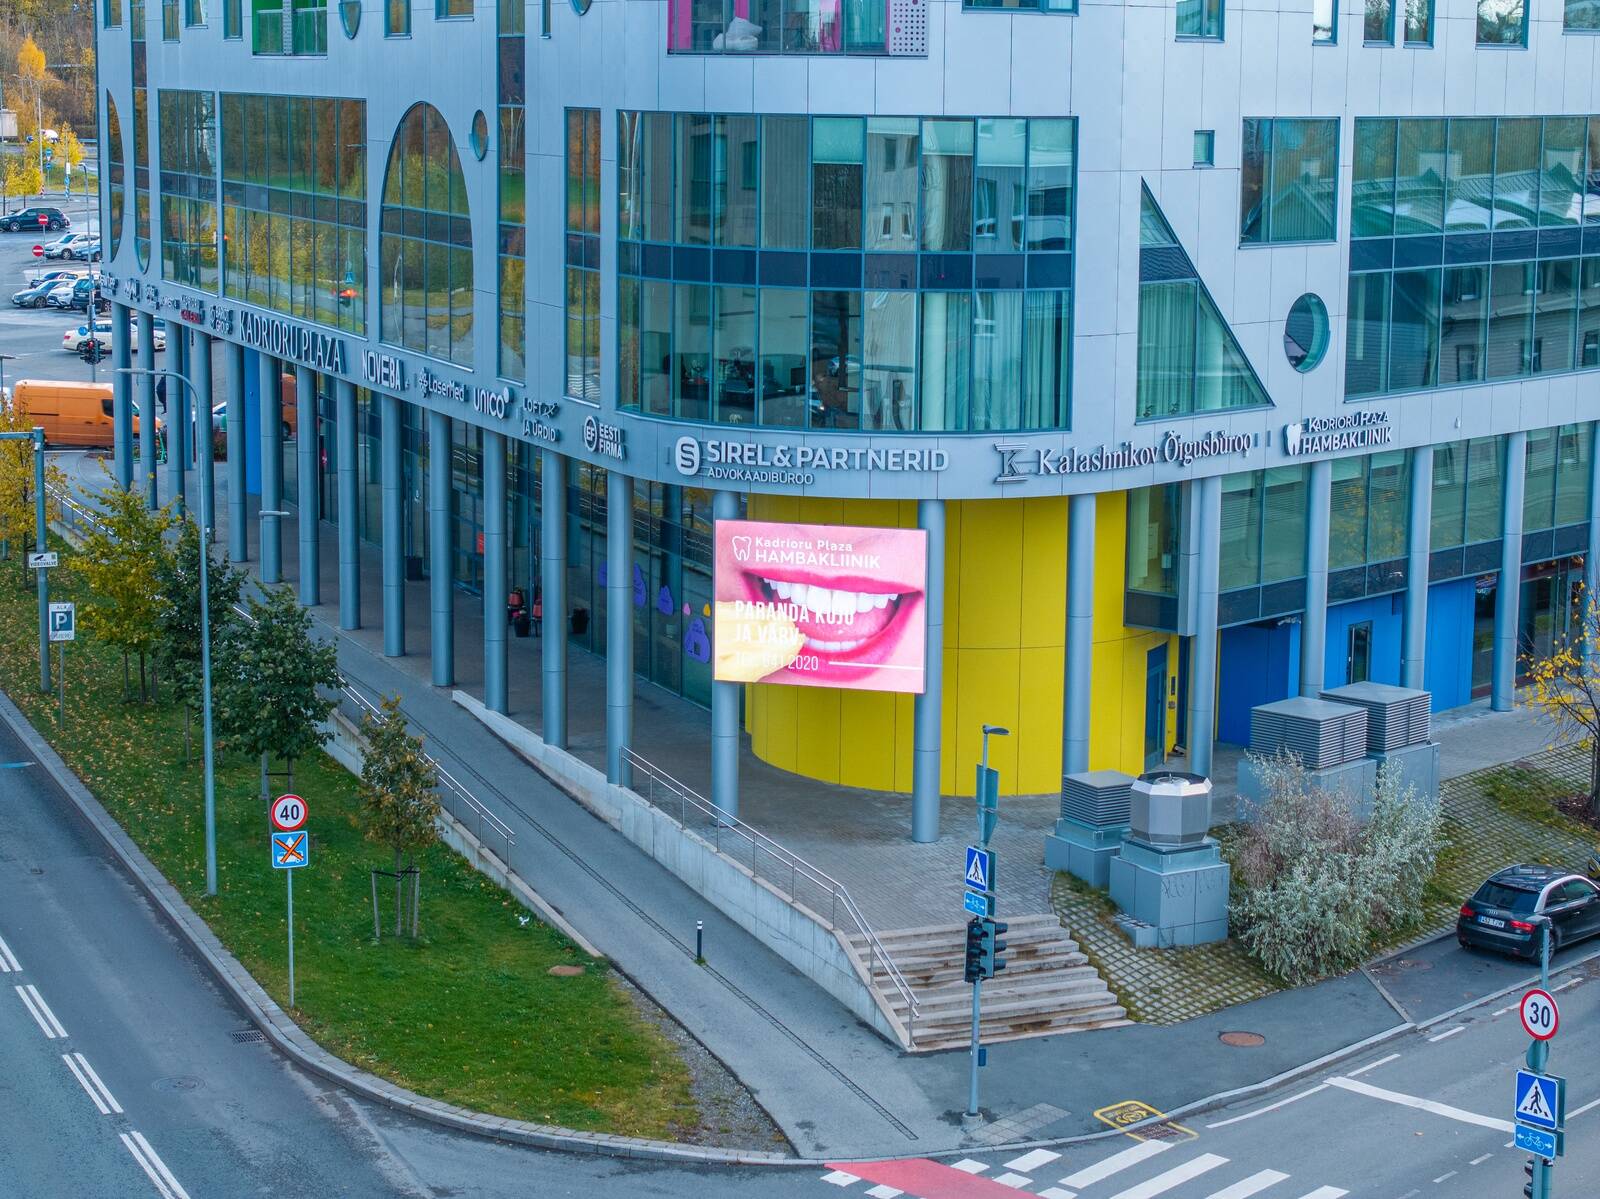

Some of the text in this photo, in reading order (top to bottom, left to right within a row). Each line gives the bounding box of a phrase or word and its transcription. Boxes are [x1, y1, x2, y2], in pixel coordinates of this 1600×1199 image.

[239, 311, 343, 374] KADRIORU PLAZA
[362, 350, 401, 391] NOVEBA
[428, 373, 465, 402] LaserMed
[473, 388, 506, 419] UNICO
[523, 396, 542, 415] LOFT
[599, 423, 621, 443] EESTI
[1308, 414, 1360, 433] KADRIORU
[599, 438, 623, 460] FIRMA
[1301, 427, 1393, 455] HAMBAKLIINIK
[1037, 440, 1160, 476] Kalashnikov
[1164, 430, 1253, 469] Õigusbüroo
[707, 467, 814, 485] ADVOKAADIBÜROO
[755, 536, 853, 552] Kadrioru Plaza
[755, 549, 881, 569] HAMBAKLIINIK
[55, 612, 68, 630] P
[735, 600, 810, 624] PARANDA
[787, 655, 819, 671] 2020
[280, 804, 300, 821] 40
[1529, 1001, 1551, 1029] 30
